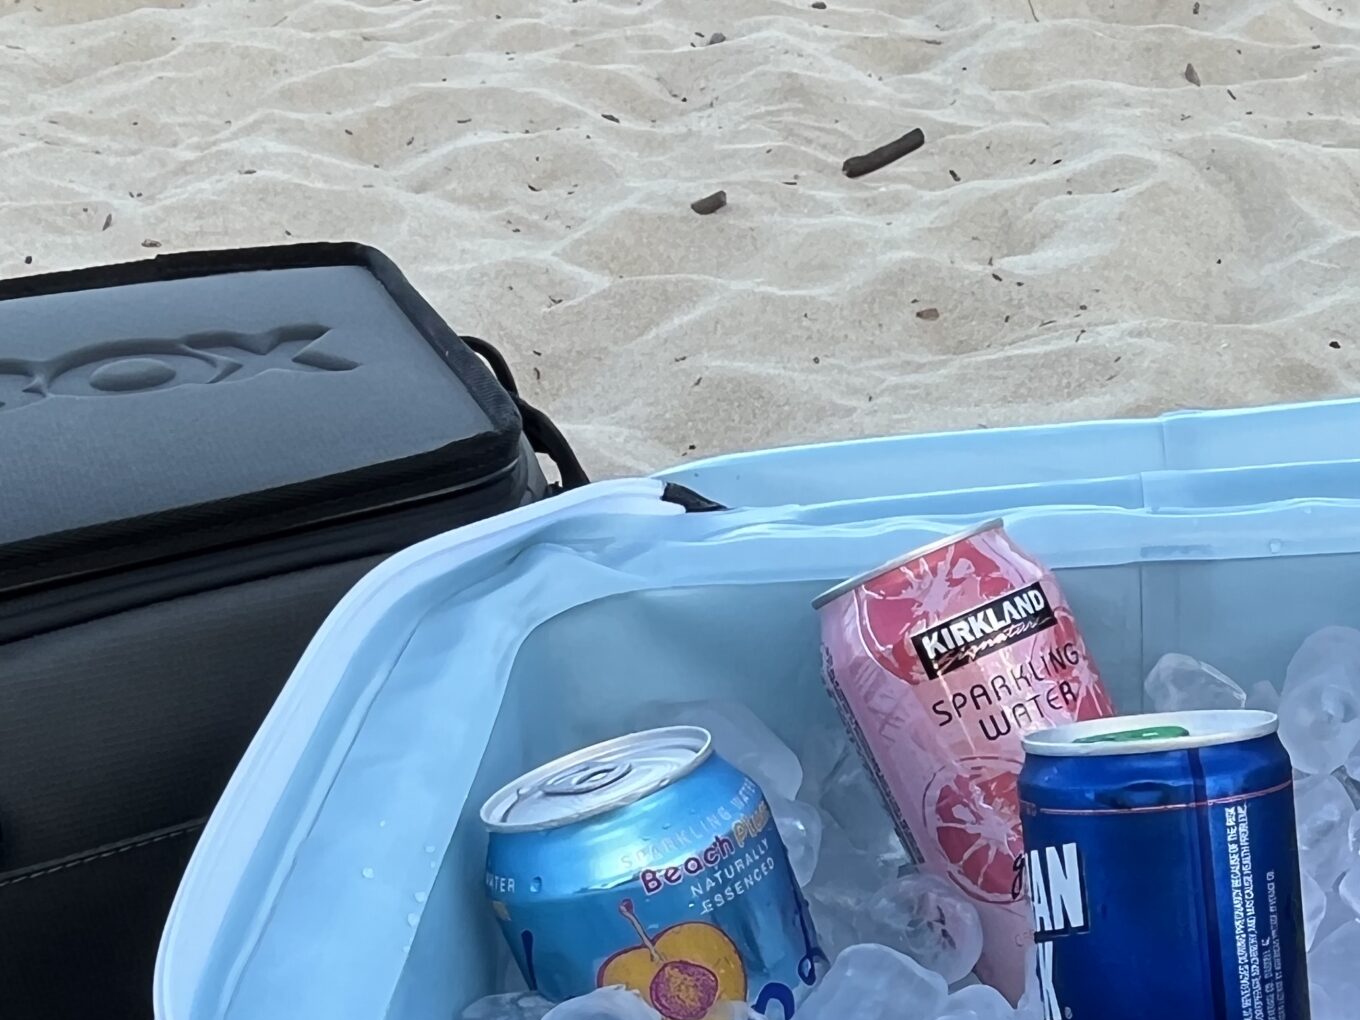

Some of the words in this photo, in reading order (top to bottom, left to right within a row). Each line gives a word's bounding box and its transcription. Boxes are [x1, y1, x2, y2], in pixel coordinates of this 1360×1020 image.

[921, 589, 1046, 660] KIRKLAND
[932, 642, 1080, 727] SPARKLING
[979, 681, 1080, 741] WATER
[621, 807, 732, 868] SPARKLING
[640, 834, 736, 895] Beach
[690, 838, 770, 898] NATURALLY
[700, 857, 775, 915] ESSENCED
